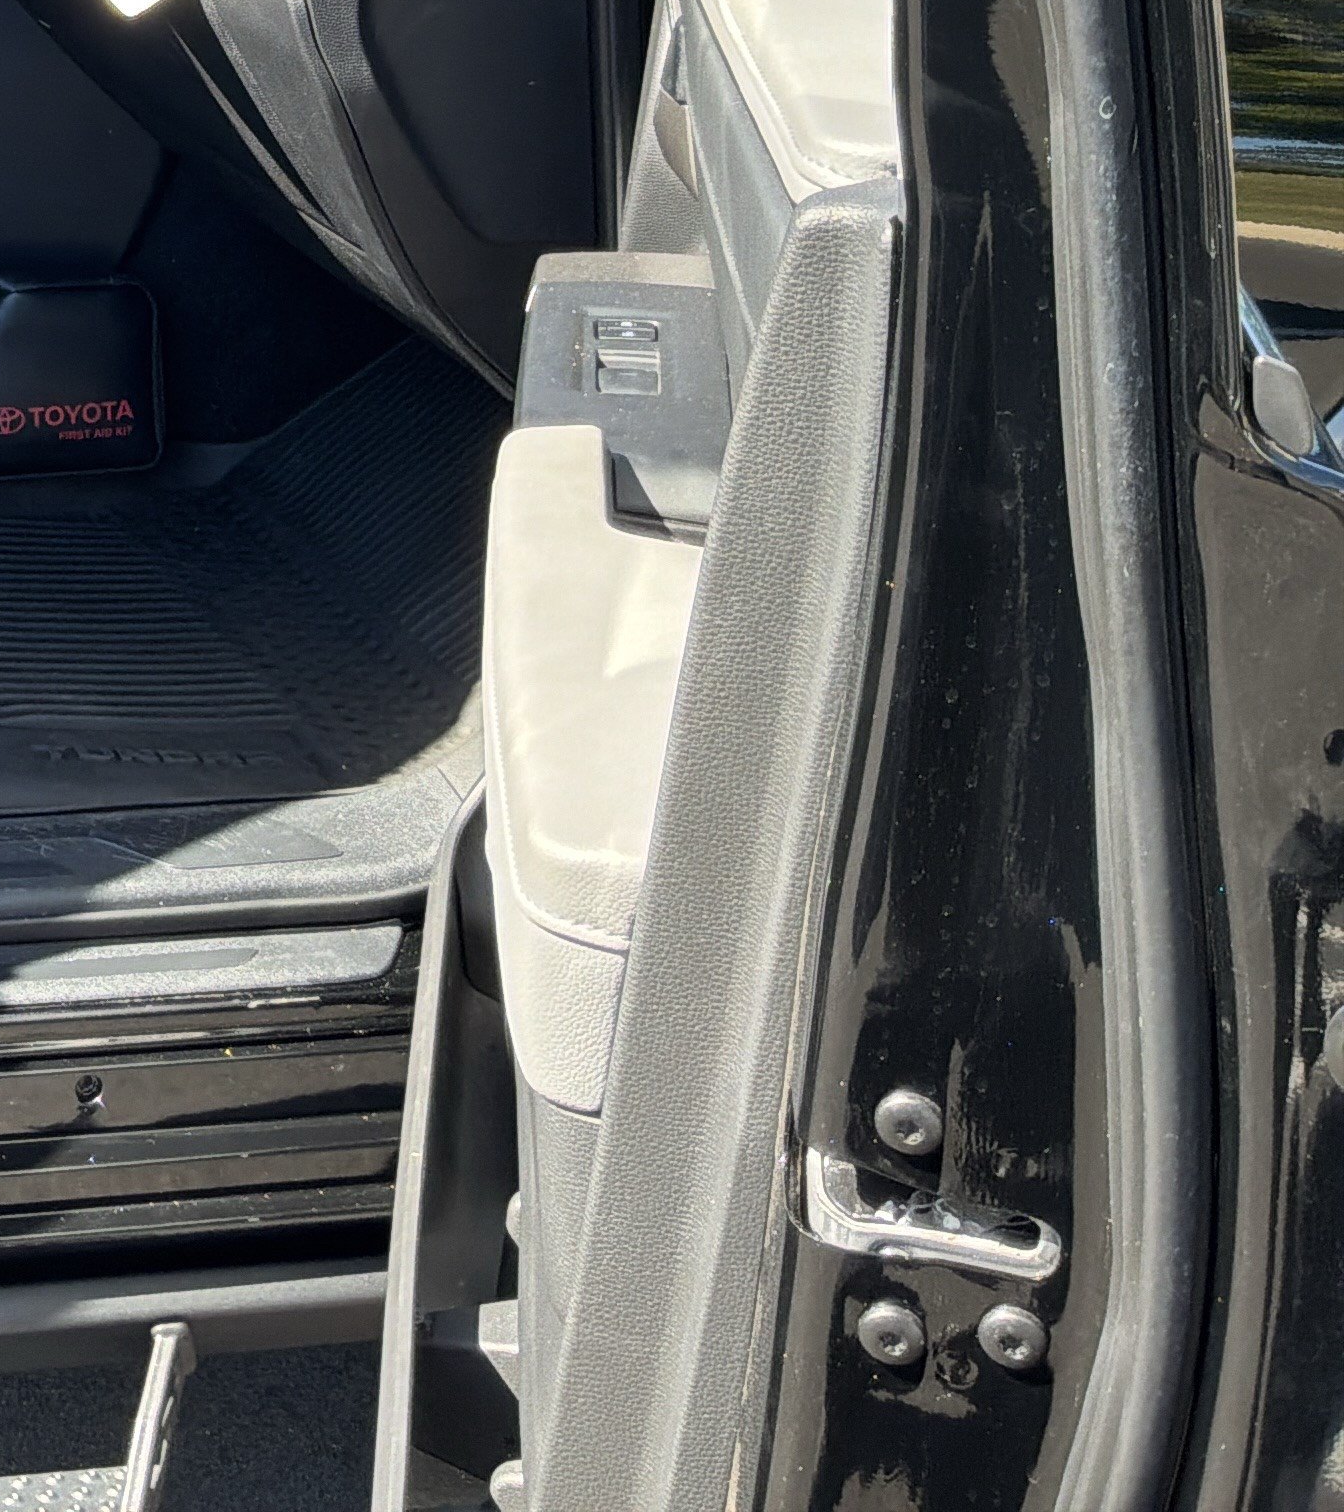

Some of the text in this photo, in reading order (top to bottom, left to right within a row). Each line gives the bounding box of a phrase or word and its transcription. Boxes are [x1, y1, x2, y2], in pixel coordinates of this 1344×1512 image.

[28, 399, 134, 428] TOYOTA
[58, 425, 133, 440] FIRST AID KIT
